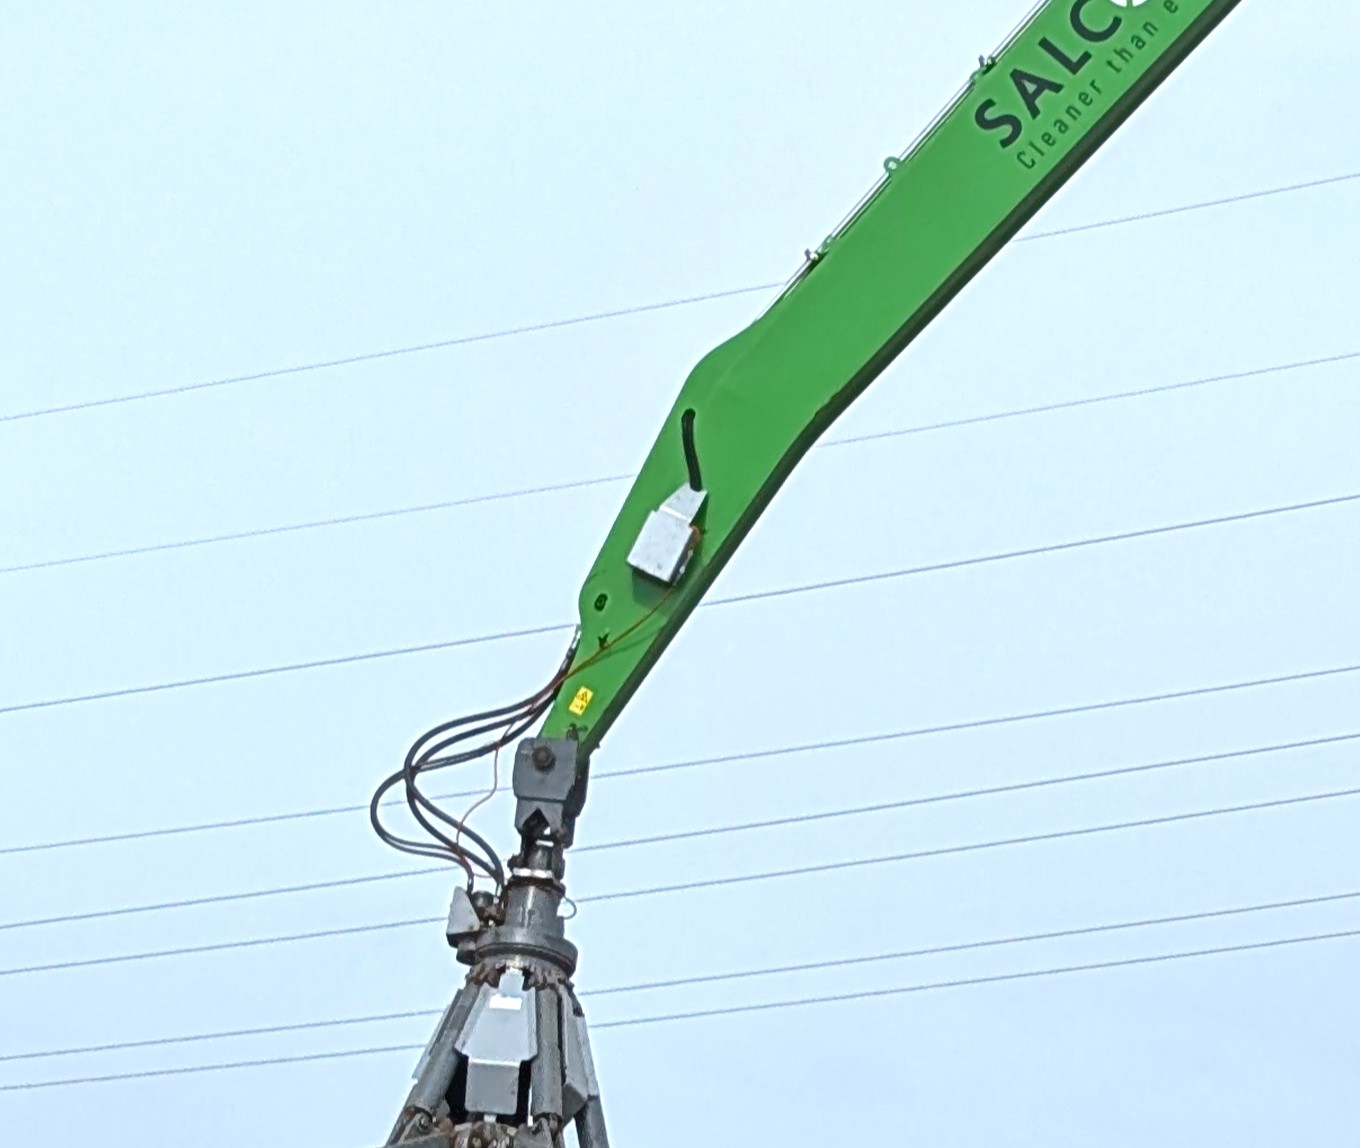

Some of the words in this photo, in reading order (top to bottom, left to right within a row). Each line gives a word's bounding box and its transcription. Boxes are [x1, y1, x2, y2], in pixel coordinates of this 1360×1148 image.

[974, 0, 1152, 149] SALC
[1017, 79, 1103, 170] Cleaner
[1106, 20, 1159, 74] than
